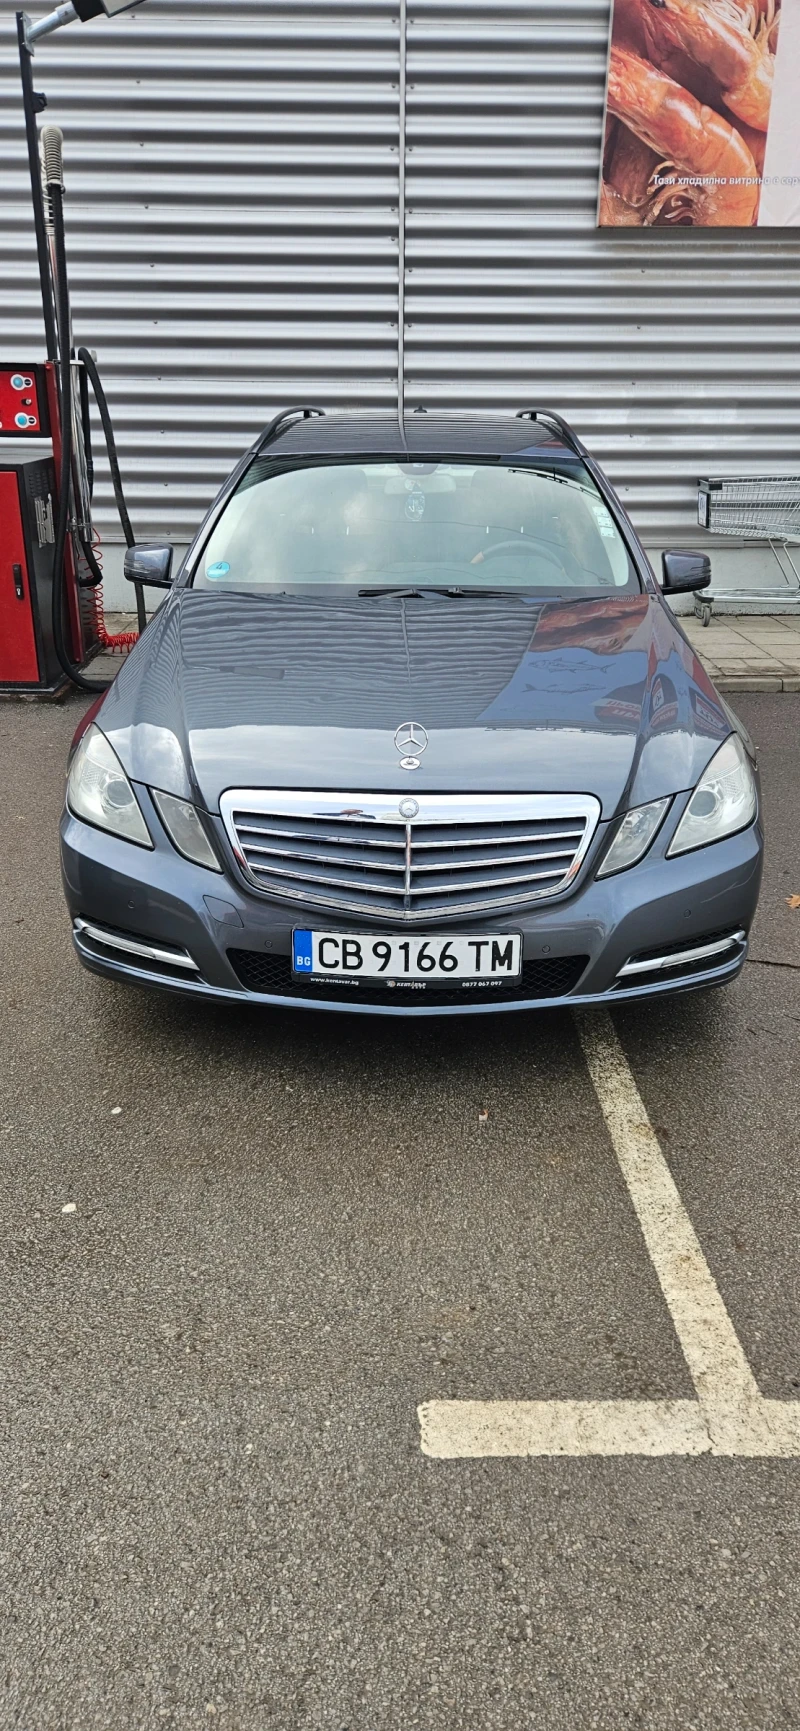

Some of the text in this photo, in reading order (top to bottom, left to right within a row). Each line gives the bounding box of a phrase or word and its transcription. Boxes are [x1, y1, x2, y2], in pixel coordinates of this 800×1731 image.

[653, 174, 676, 185] Тази
[677, 176, 727, 186] хладилна
[729, 176, 771, 187] витрина
[781, 177, 800, 188] сер
[296, 955, 311, 966] BG
[318, 937, 514, 972] CB 9166 TM
